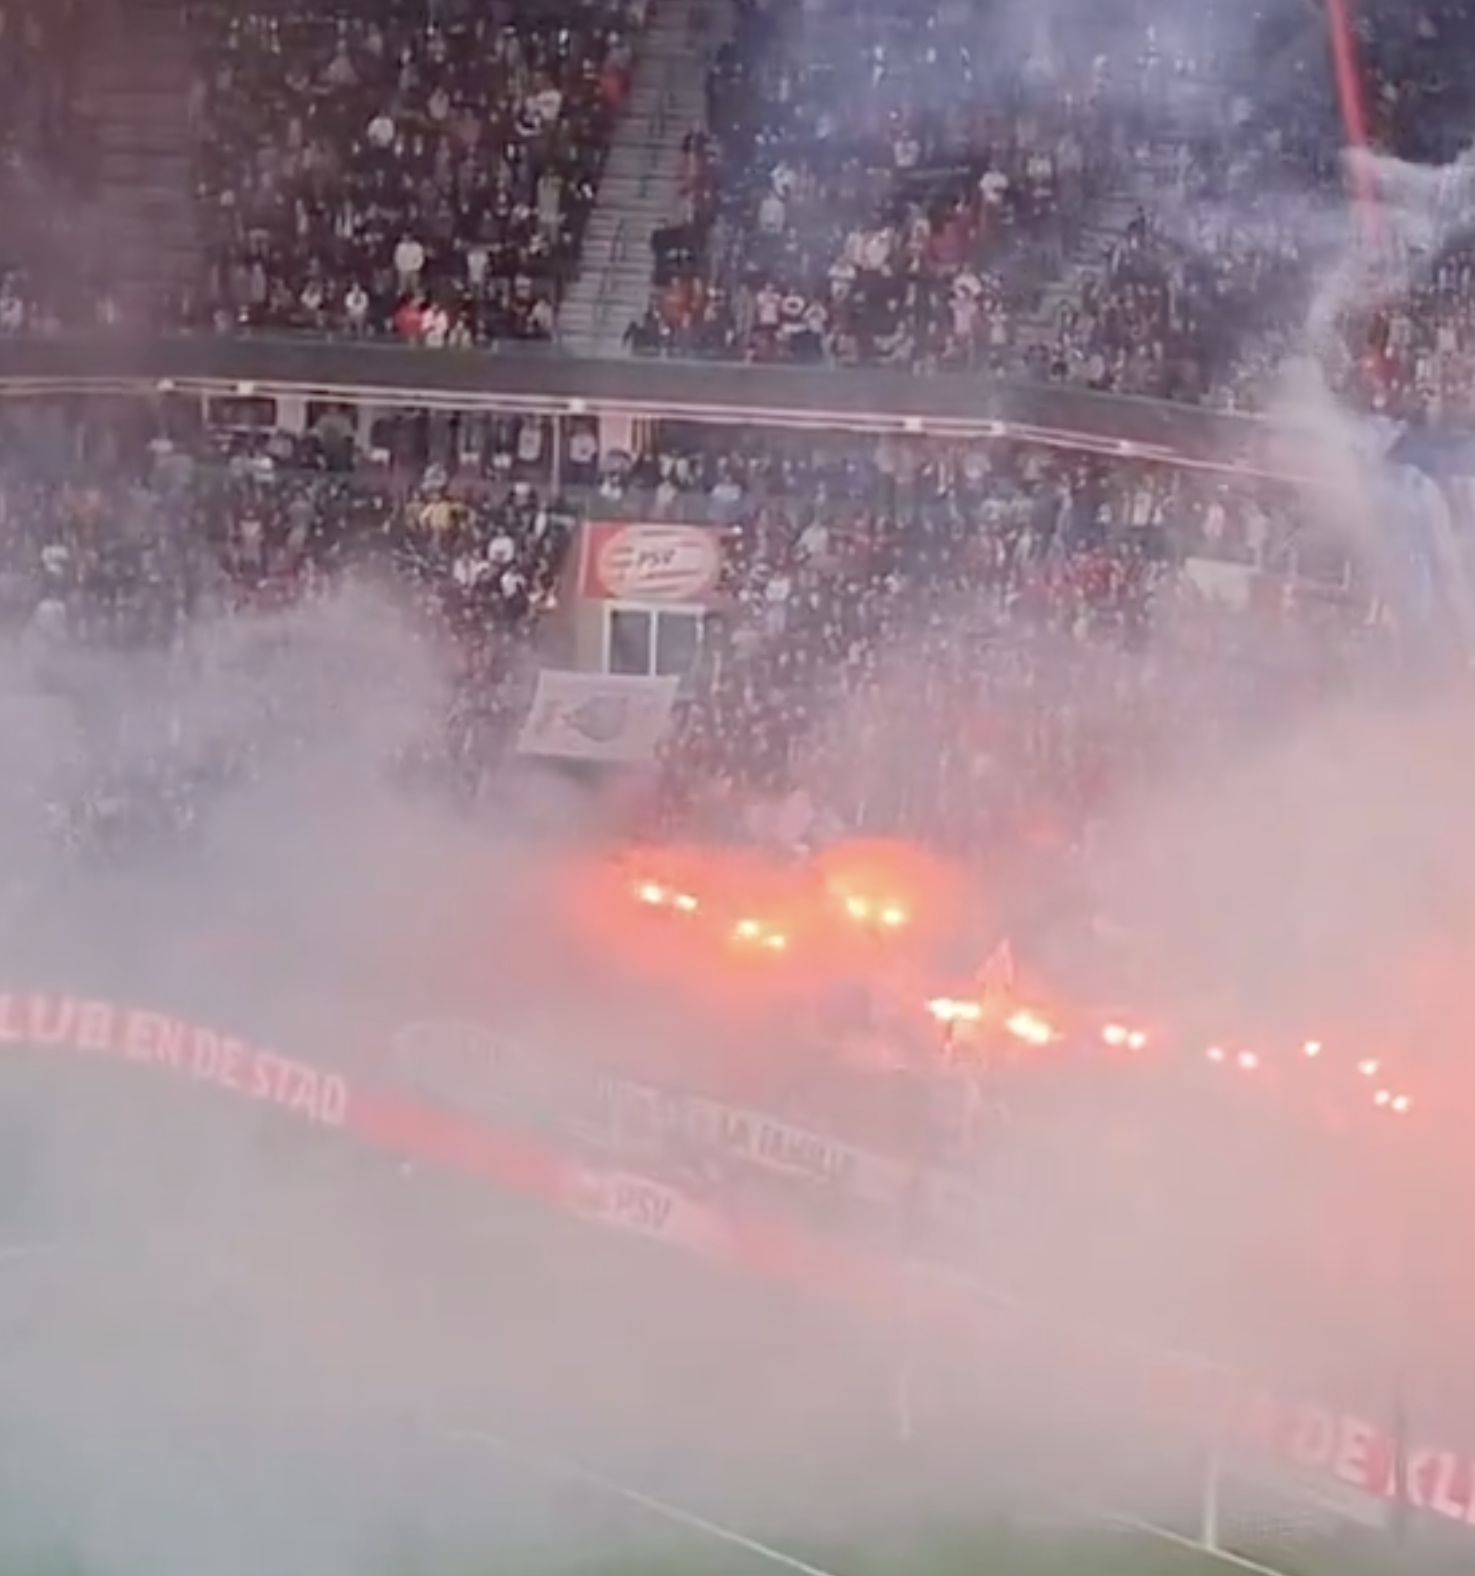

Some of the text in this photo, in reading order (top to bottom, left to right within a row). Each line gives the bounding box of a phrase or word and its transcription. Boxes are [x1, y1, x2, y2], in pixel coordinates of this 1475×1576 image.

[123, 1007, 185, 1067] EN
[192, 1026, 247, 1089] DE
[250, 1049, 348, 1127] STAD
[1292, 1401, 1376, 1486] DE
